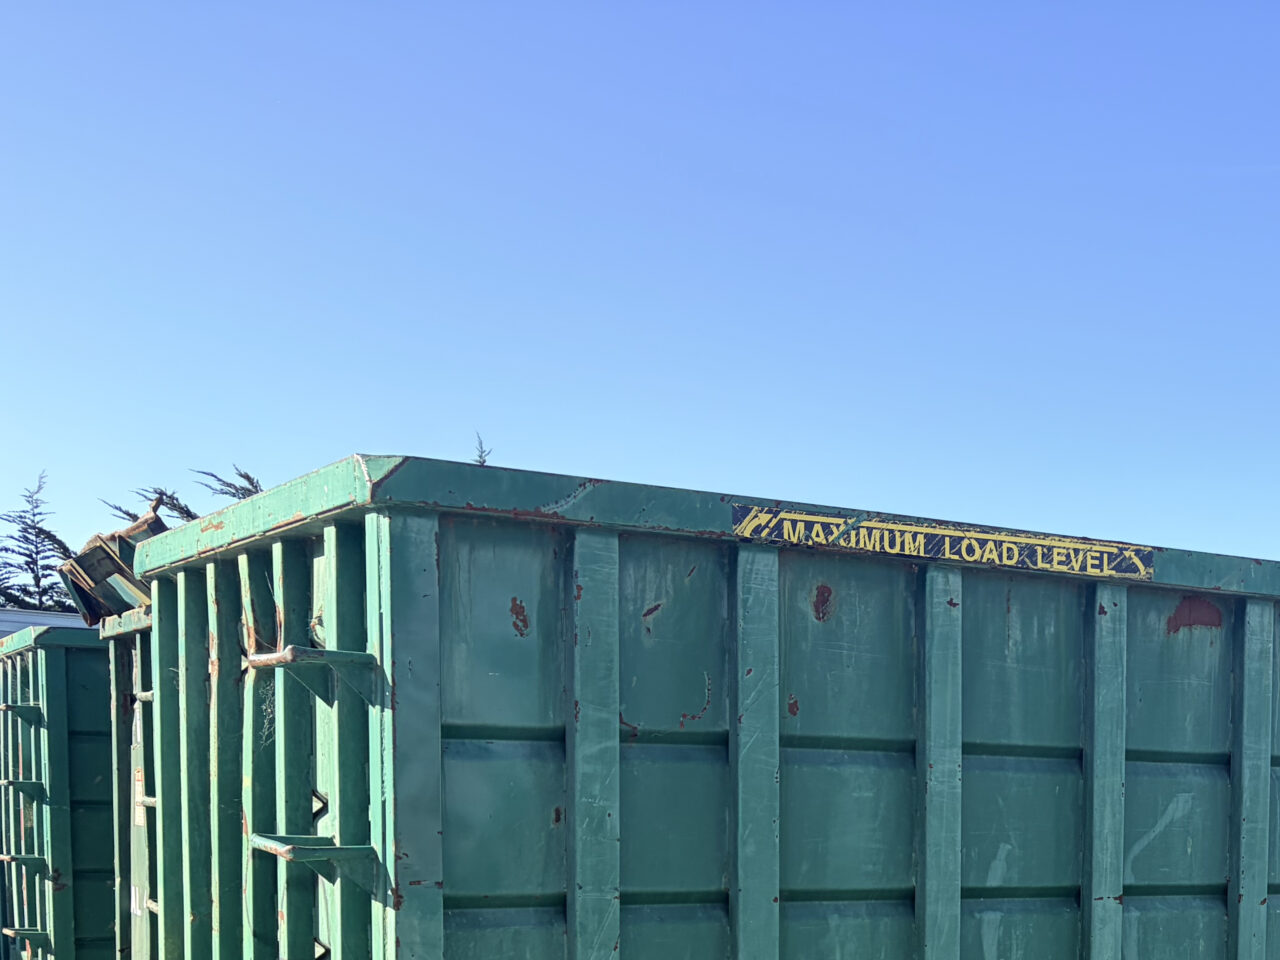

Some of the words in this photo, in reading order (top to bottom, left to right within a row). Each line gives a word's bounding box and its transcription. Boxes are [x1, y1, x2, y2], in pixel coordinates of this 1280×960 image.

[783, 520, 926, 556] MAXIMUM
[944, 536, 1019, 566] LOAD
[1034, 545, 1116, 575] LEVEL
